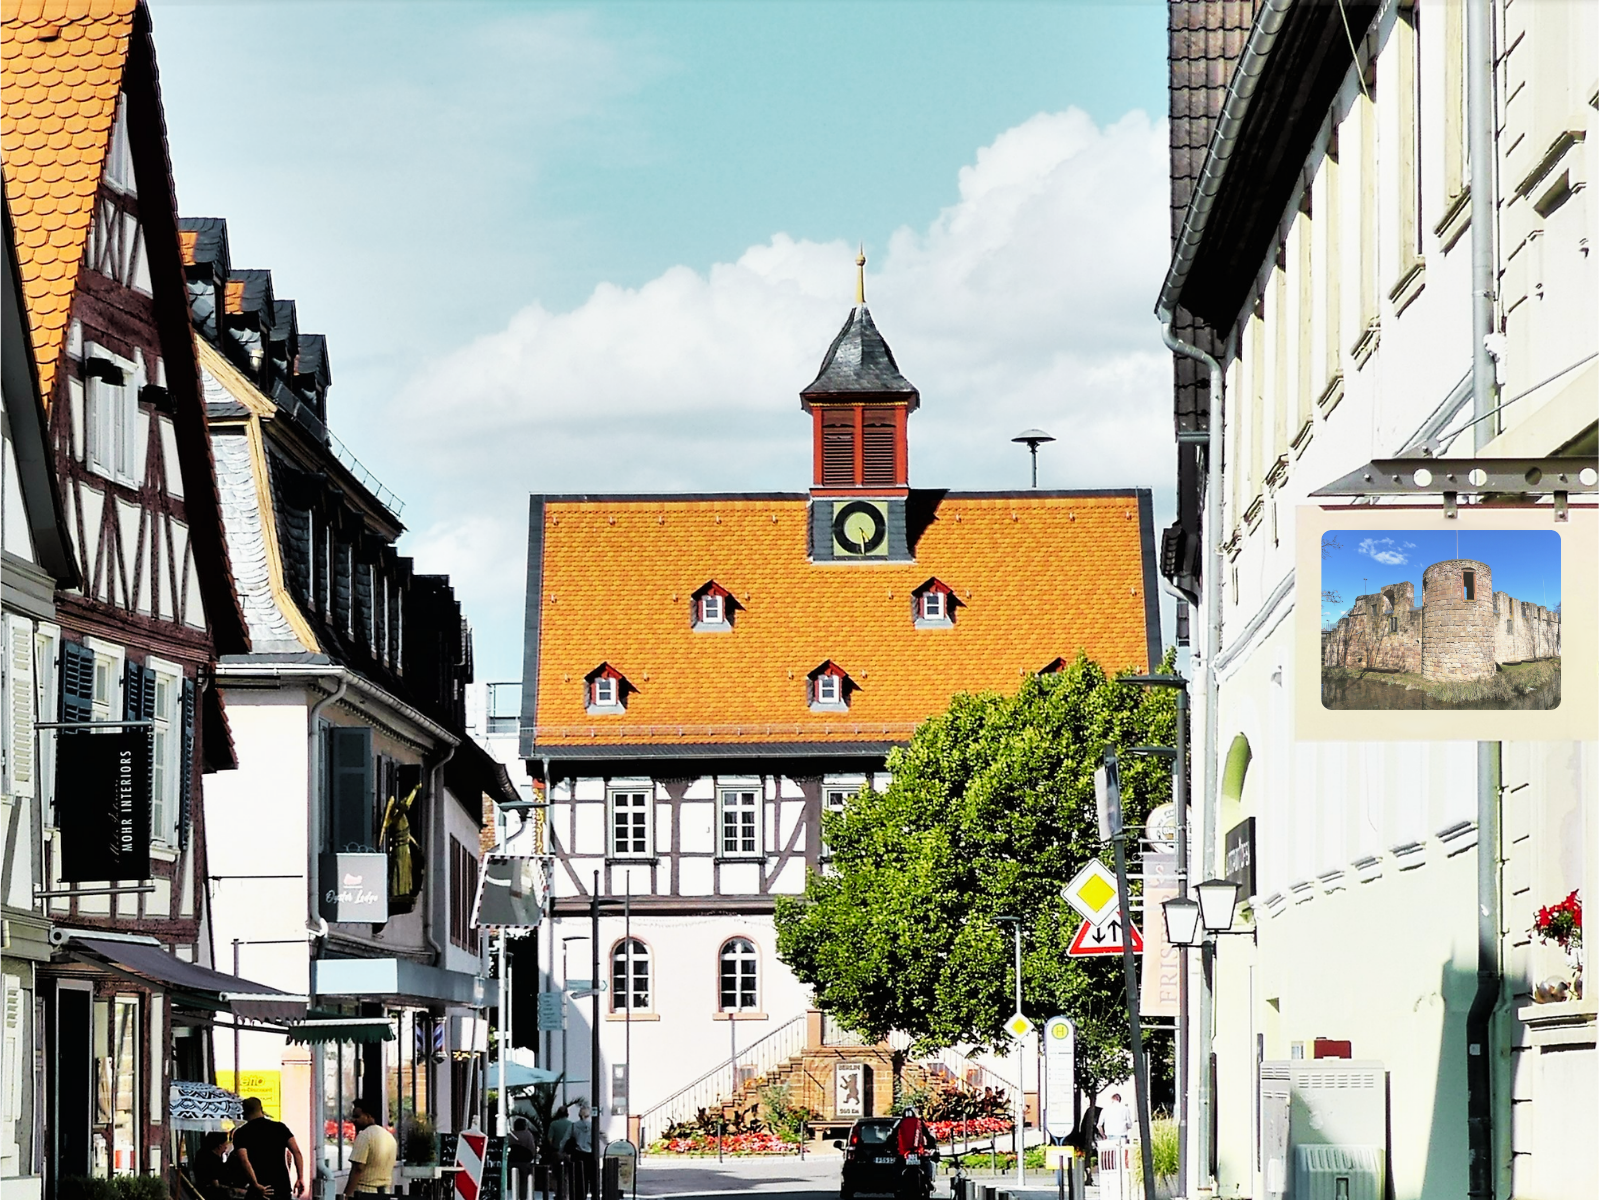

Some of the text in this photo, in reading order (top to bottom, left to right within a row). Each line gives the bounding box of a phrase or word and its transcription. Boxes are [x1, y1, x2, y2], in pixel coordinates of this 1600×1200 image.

[120, 750, 133, 852] MOHR INTERIORS
[1159, 893, 1178, 1004] FRISR
